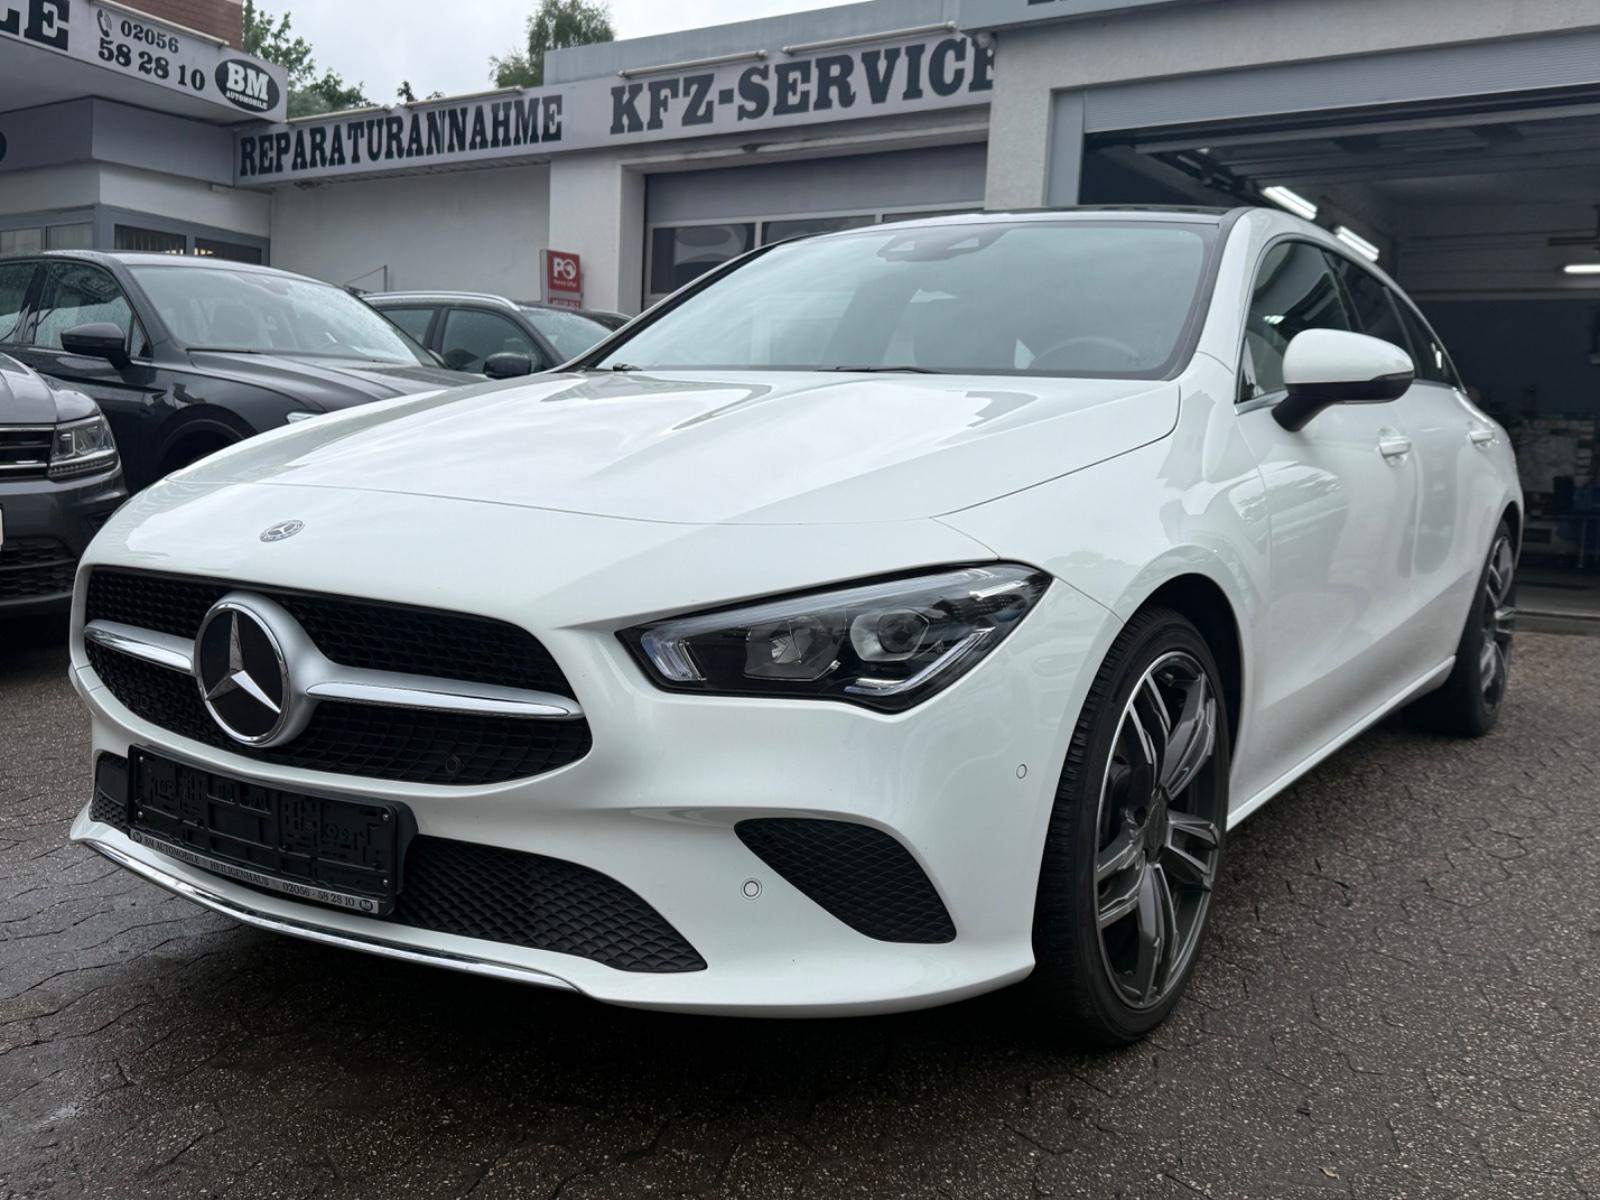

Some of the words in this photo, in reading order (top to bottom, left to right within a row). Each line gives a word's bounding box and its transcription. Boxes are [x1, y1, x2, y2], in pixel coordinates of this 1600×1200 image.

[120, 20, 179, 53] 02056
[98, 37, 132, 67] 58
[138, 51, 169, 79] 28
[178, 64, 206, 91] 10
[226, 61, 270, 102] BM
[225, 90, 269, 110] AUTOMOBILE
[610, 37, 995, 135] KFZ-SERVICE
[240, 94, 562, 176] REPARATURANNAHME
[282, 882, 310, 897] 02056
[319, 890, 329, 901] 58
[332, 893, 343, 904] 28
[345, 897, 355, 907] 10
